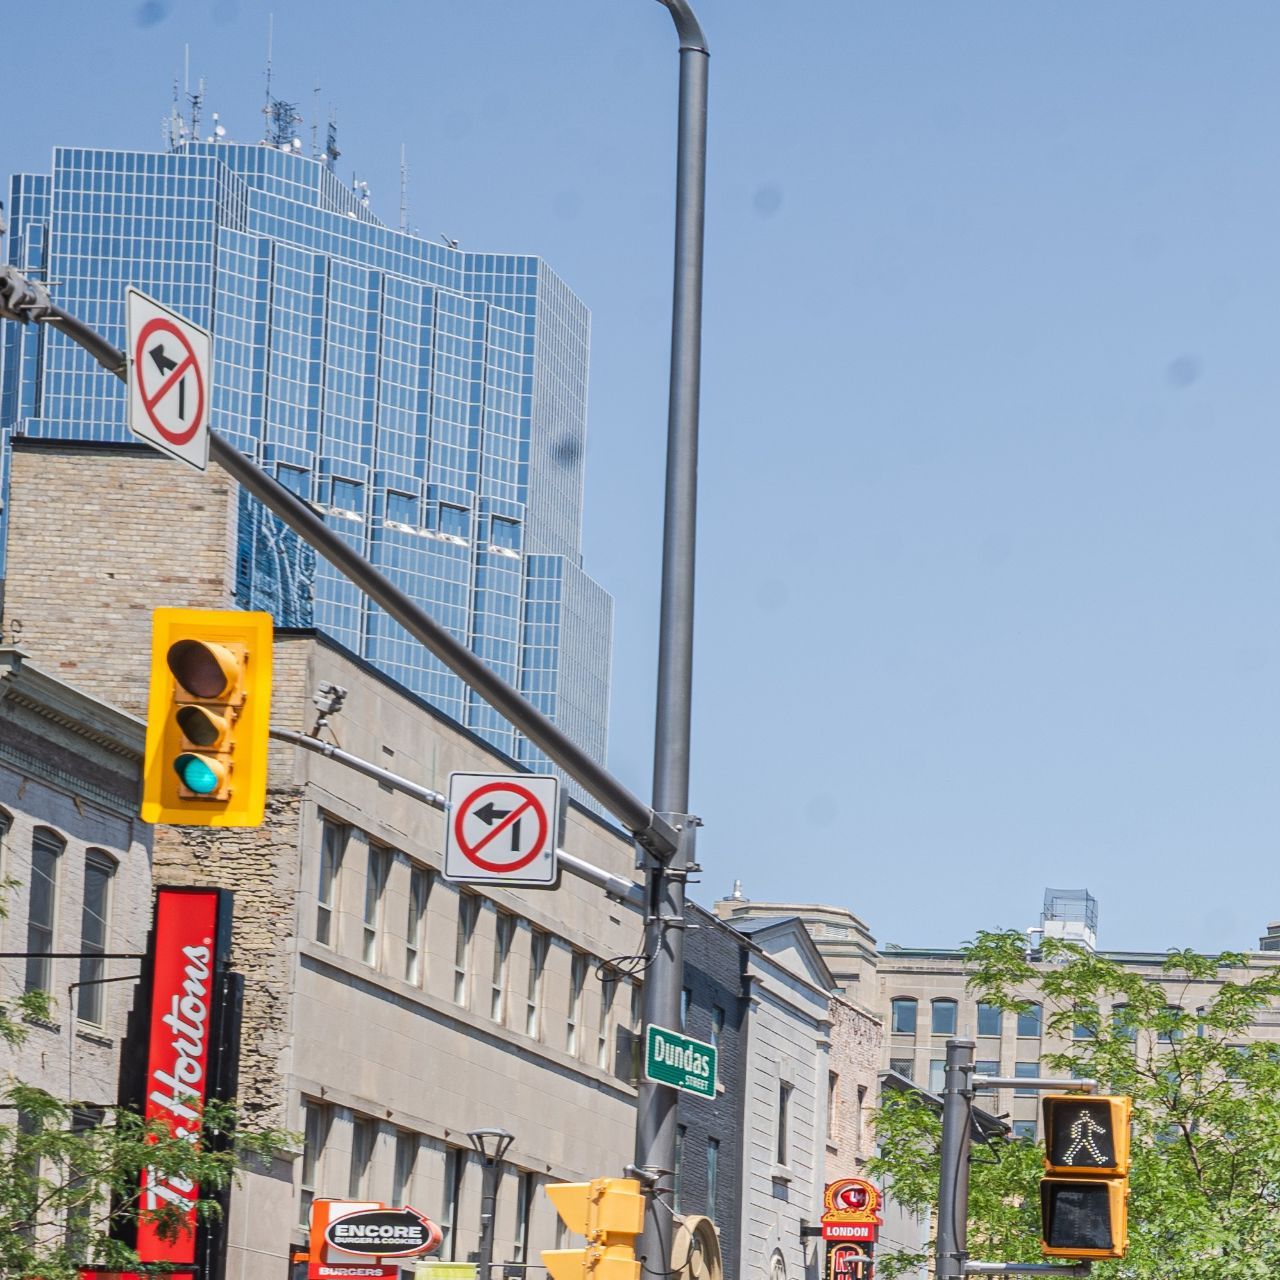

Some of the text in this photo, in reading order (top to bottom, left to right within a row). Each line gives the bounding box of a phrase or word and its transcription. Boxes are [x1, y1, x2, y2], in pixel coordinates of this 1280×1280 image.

[149, 943, 211, 1120] Hortons
[654, 1035, 710, 1077] Dundas
[685, 1075, 709, 1090] STREET
[334, 1224, 423, 1239] ENCORE
[826, 1226, 869, 1238] LONDON
[381, 1237, 423, 1245] COOKIES
[318, 1267, 384, 1277] BURGERS
